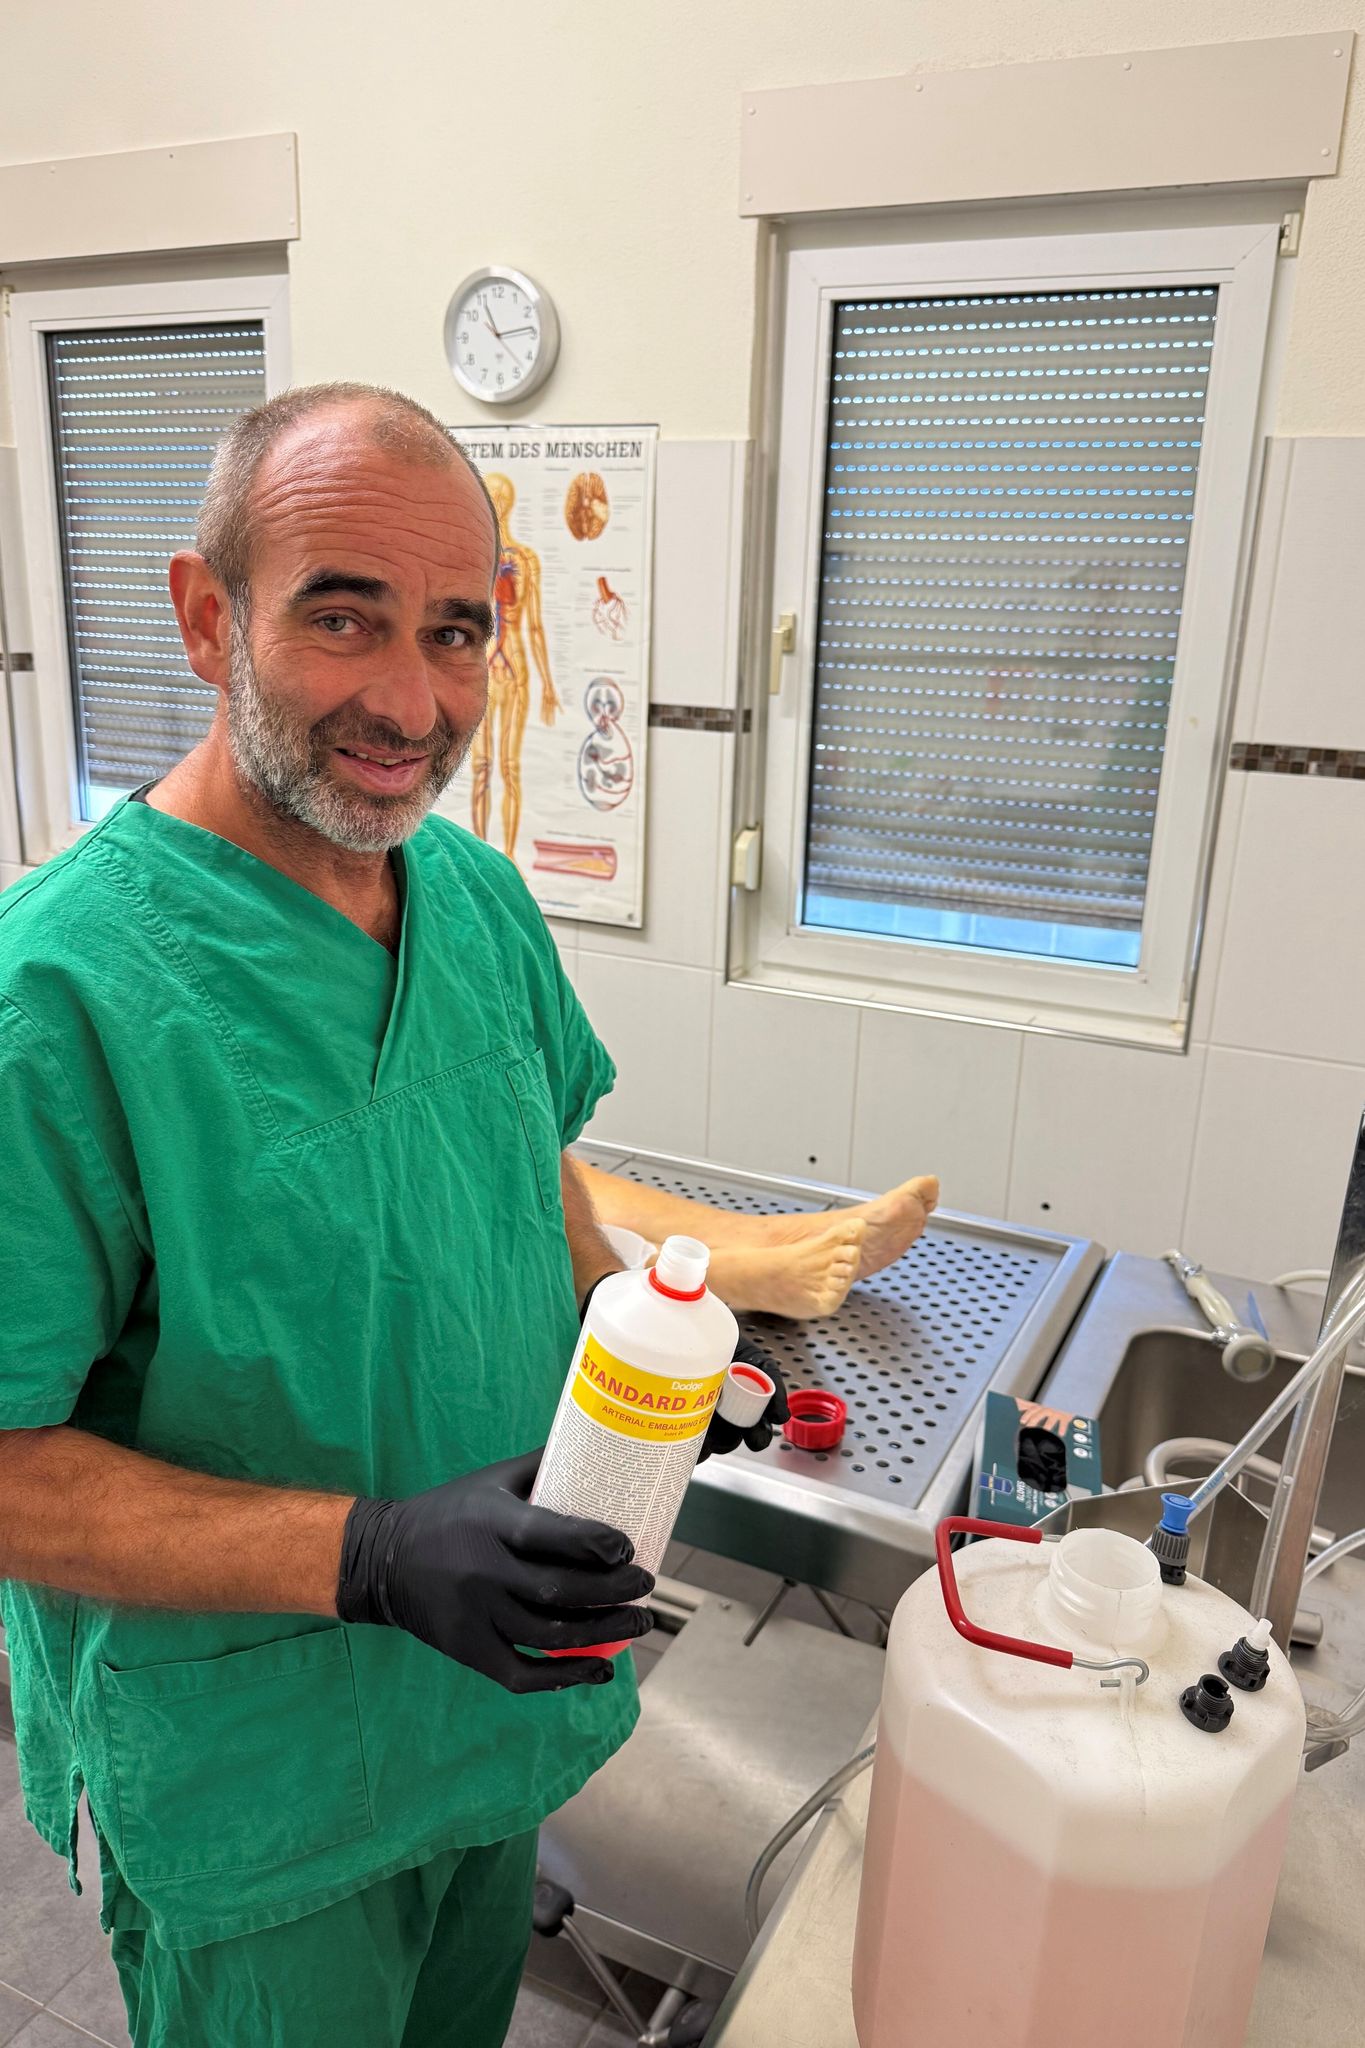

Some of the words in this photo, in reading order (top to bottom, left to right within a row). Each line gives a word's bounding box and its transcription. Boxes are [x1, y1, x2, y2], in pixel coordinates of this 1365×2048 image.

[492, 286, 505, 299] 12
[477, 293, 488, 306] 11
[467, 309, 479, 322] 10
[509, 443, 541, 458] DES
[545, 441, 643, 459] MENSCHEN
[582, 1353, 687, 1411] STANDARD
[672, 1381, 703, 1392] Dodge
[602, 1405, 646, 1427] ARTERIAL
[648, 1420, 698, 1431] EMBALMING
